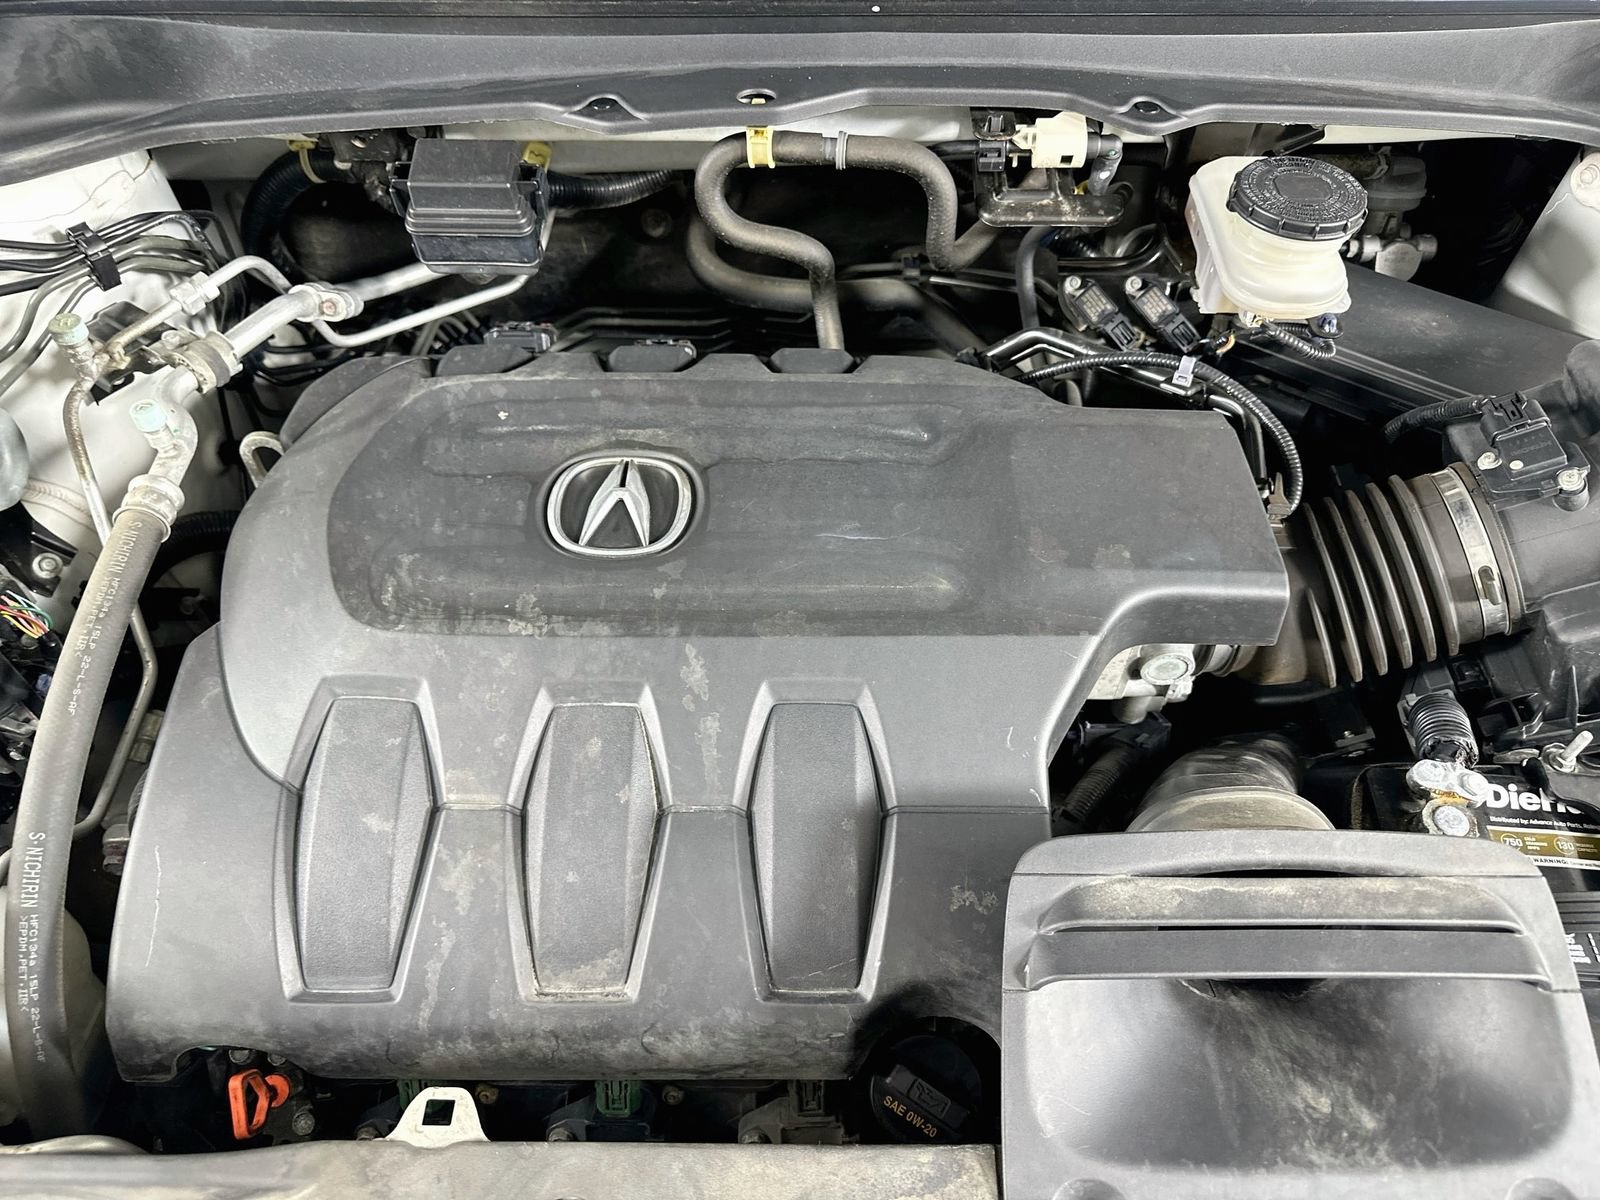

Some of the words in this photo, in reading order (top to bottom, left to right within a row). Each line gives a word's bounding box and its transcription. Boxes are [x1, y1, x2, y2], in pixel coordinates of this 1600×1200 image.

[1486, 783, 1583, 814] DieH
[1557, 841, 1575, 850] 130
[28, 914, 38, 966] HFC134a
[883, 1095, 907, 1116] SAE
[905, 1111, 937, 1137] 0W-20
